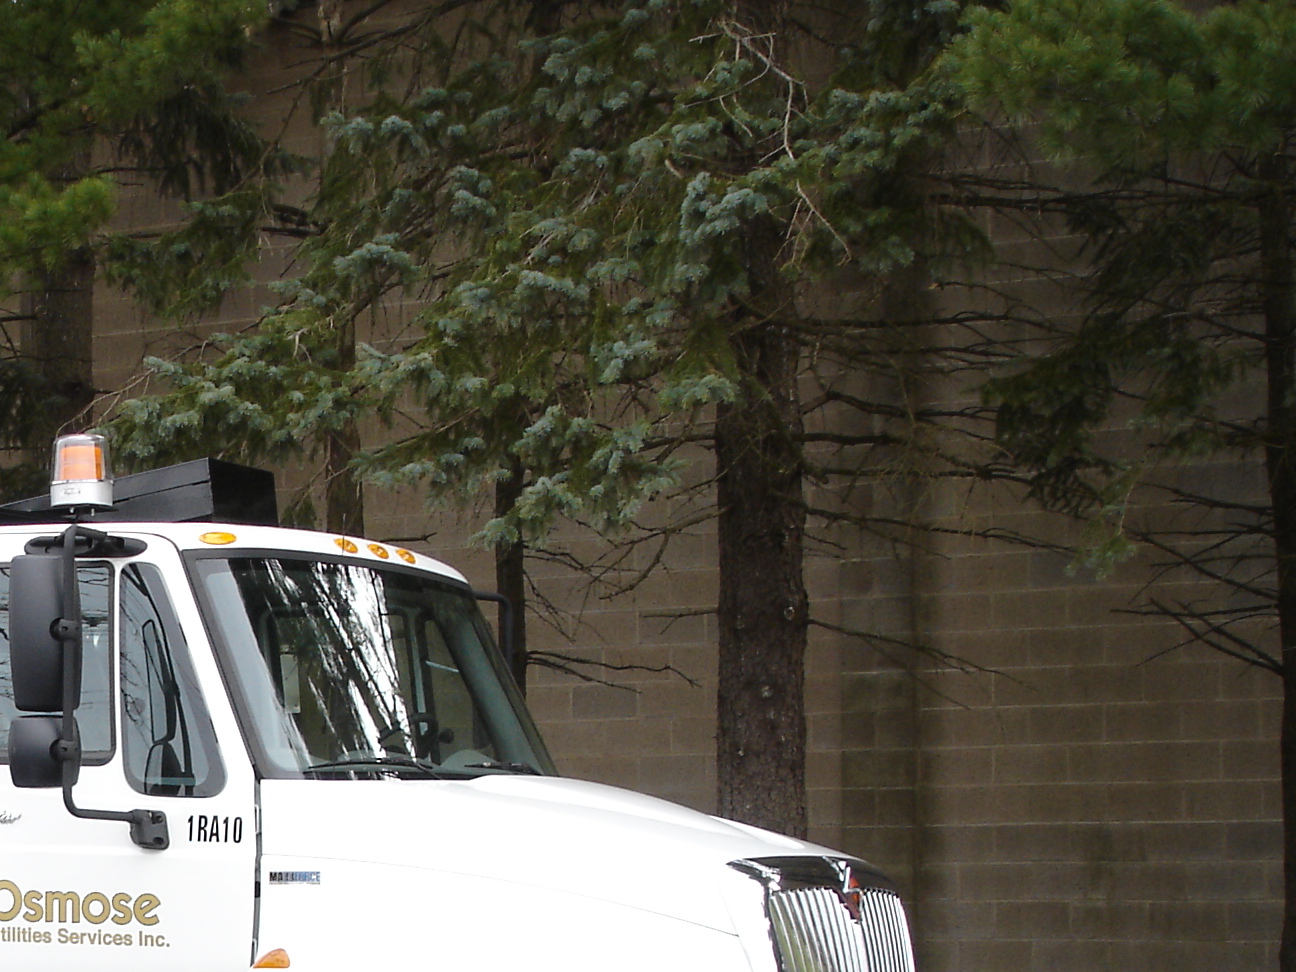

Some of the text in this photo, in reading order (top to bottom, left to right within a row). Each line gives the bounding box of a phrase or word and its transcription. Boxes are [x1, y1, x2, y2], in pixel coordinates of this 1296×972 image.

[187, 814, 243, 844] 1RA10
[57, 928, 133, 946] Services
[139, 931, 170, 947] Inc.
